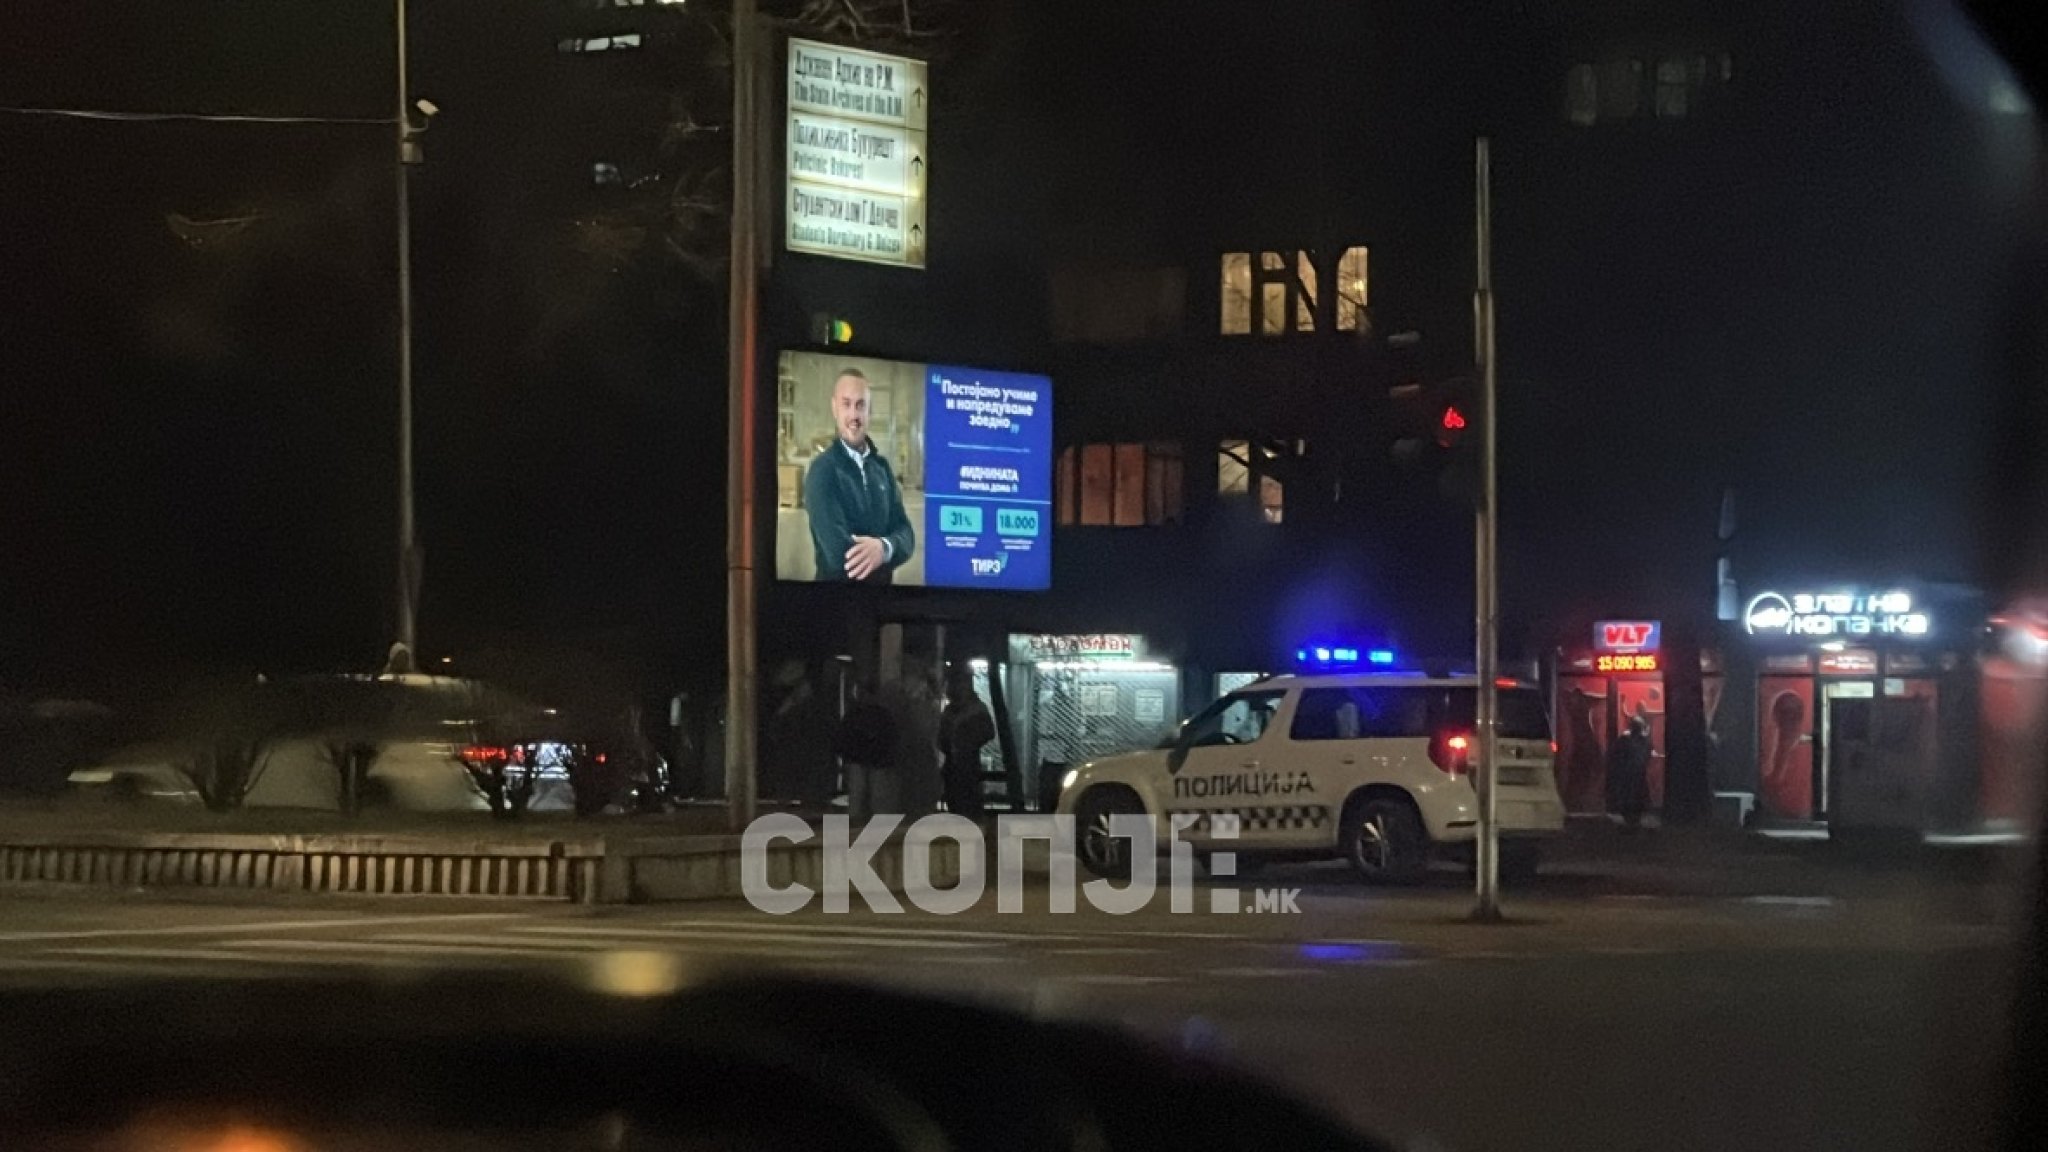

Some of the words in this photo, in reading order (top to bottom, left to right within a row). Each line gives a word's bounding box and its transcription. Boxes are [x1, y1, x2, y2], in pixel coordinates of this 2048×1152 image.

[794, 80, 808, 101] The
[810, 84, 829, 104] State
[1002, 389, 1037, 402] учиме
[946, 398, 955, 409] и
[957, 399, 1033, 416] напредуваме
[999, 514, 1035, 529] 18.000
[1604, 624, 1653, 646] VLT
[1174, 771, 1315, 798] ПОЛИЦИЈА
